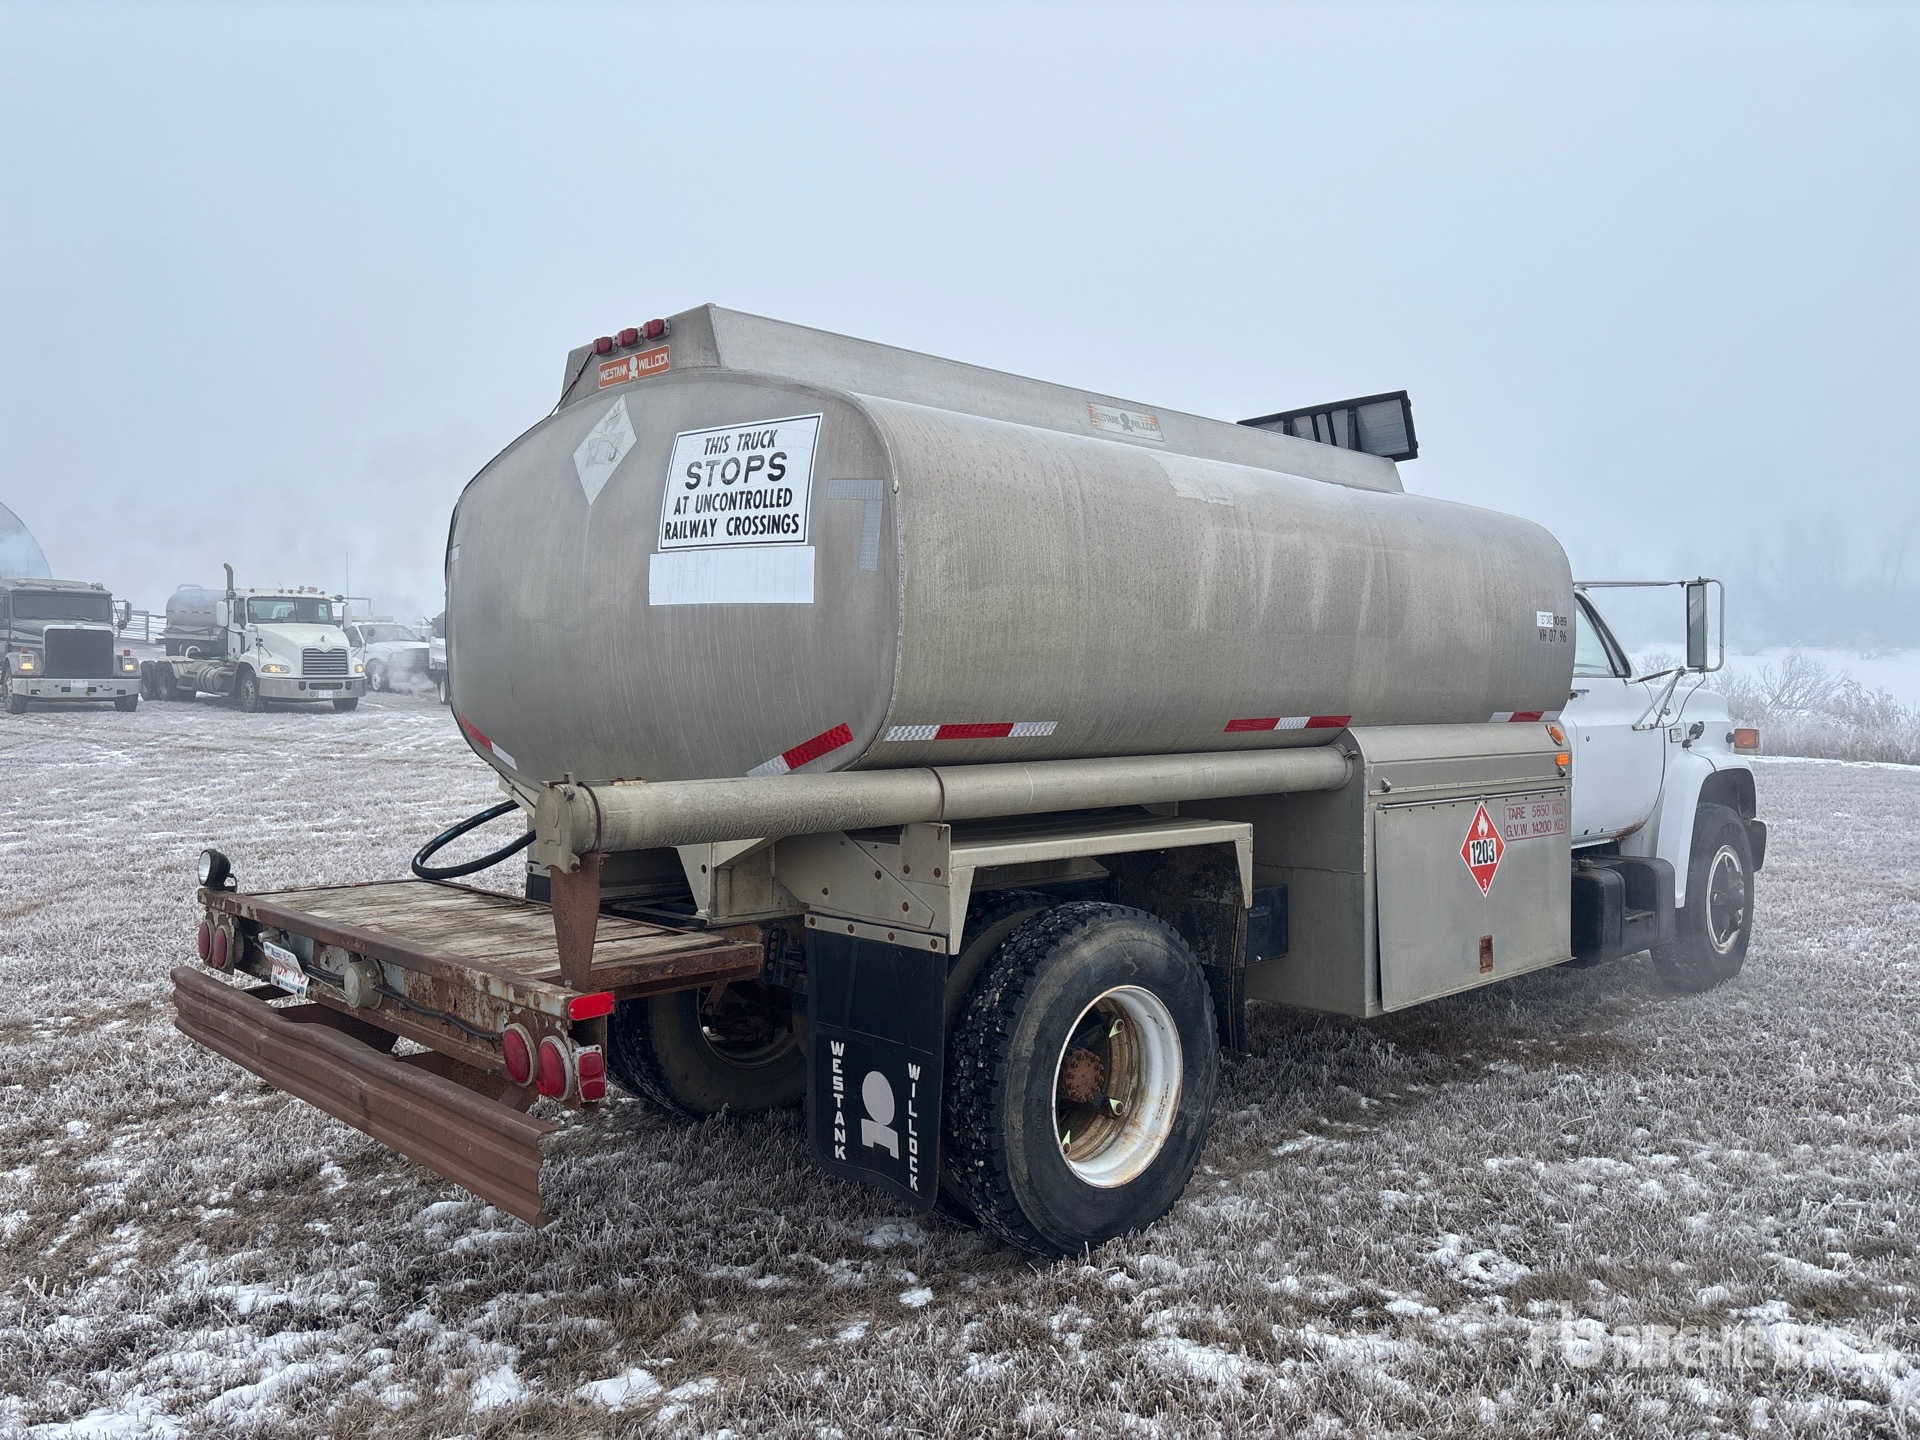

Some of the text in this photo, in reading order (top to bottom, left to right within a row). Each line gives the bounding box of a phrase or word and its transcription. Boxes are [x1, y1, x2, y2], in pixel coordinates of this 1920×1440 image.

[600, 351, 669, 382] WESTANK WILLOCK
[704, 429, 778, 455] THIS TRUCK
[685, 451, 788, 490] STOPS
[673, 487, 793, 515] AT UNCONTROLLED
[664, 513, 800, 540] RAILWAY CROSSINGS
[1559, 629, 1567, 643] 96
[1507, 806, 1526, 821] TARE
[1531, 804, 1550, 818] 5650
[1532, 820, 1552, 834] 14200
[1471, 839, 1495, 865] 1203
[1482, 878, 1488, 891] 3
[830, 1040, 847, 1161] WESTANK
[907, 1062, 921, 1192] WILLOCK
